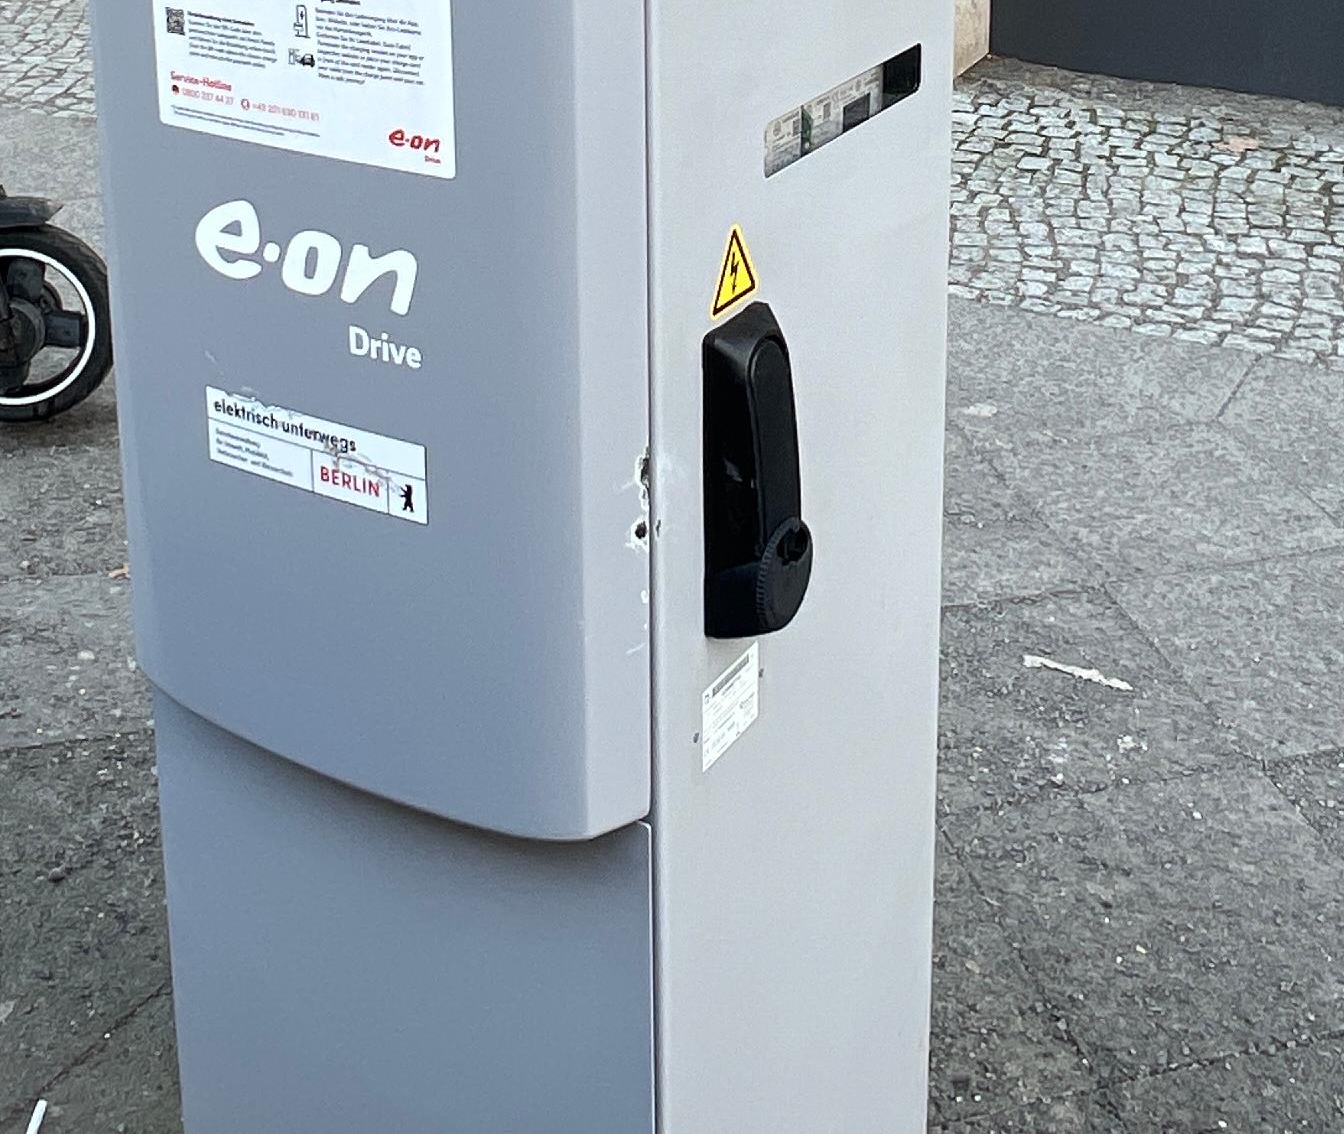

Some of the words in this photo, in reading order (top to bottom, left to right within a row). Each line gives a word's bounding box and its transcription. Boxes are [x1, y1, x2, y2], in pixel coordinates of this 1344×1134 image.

[170, 70, 232, 93] Service-Hotline
[348, 324, 423, 369] Drive
[214, 398, 279, 430] elektrisch
[282, 421, 357, 454] unterwegs
[320, 466, 382, 498] BERLIN
